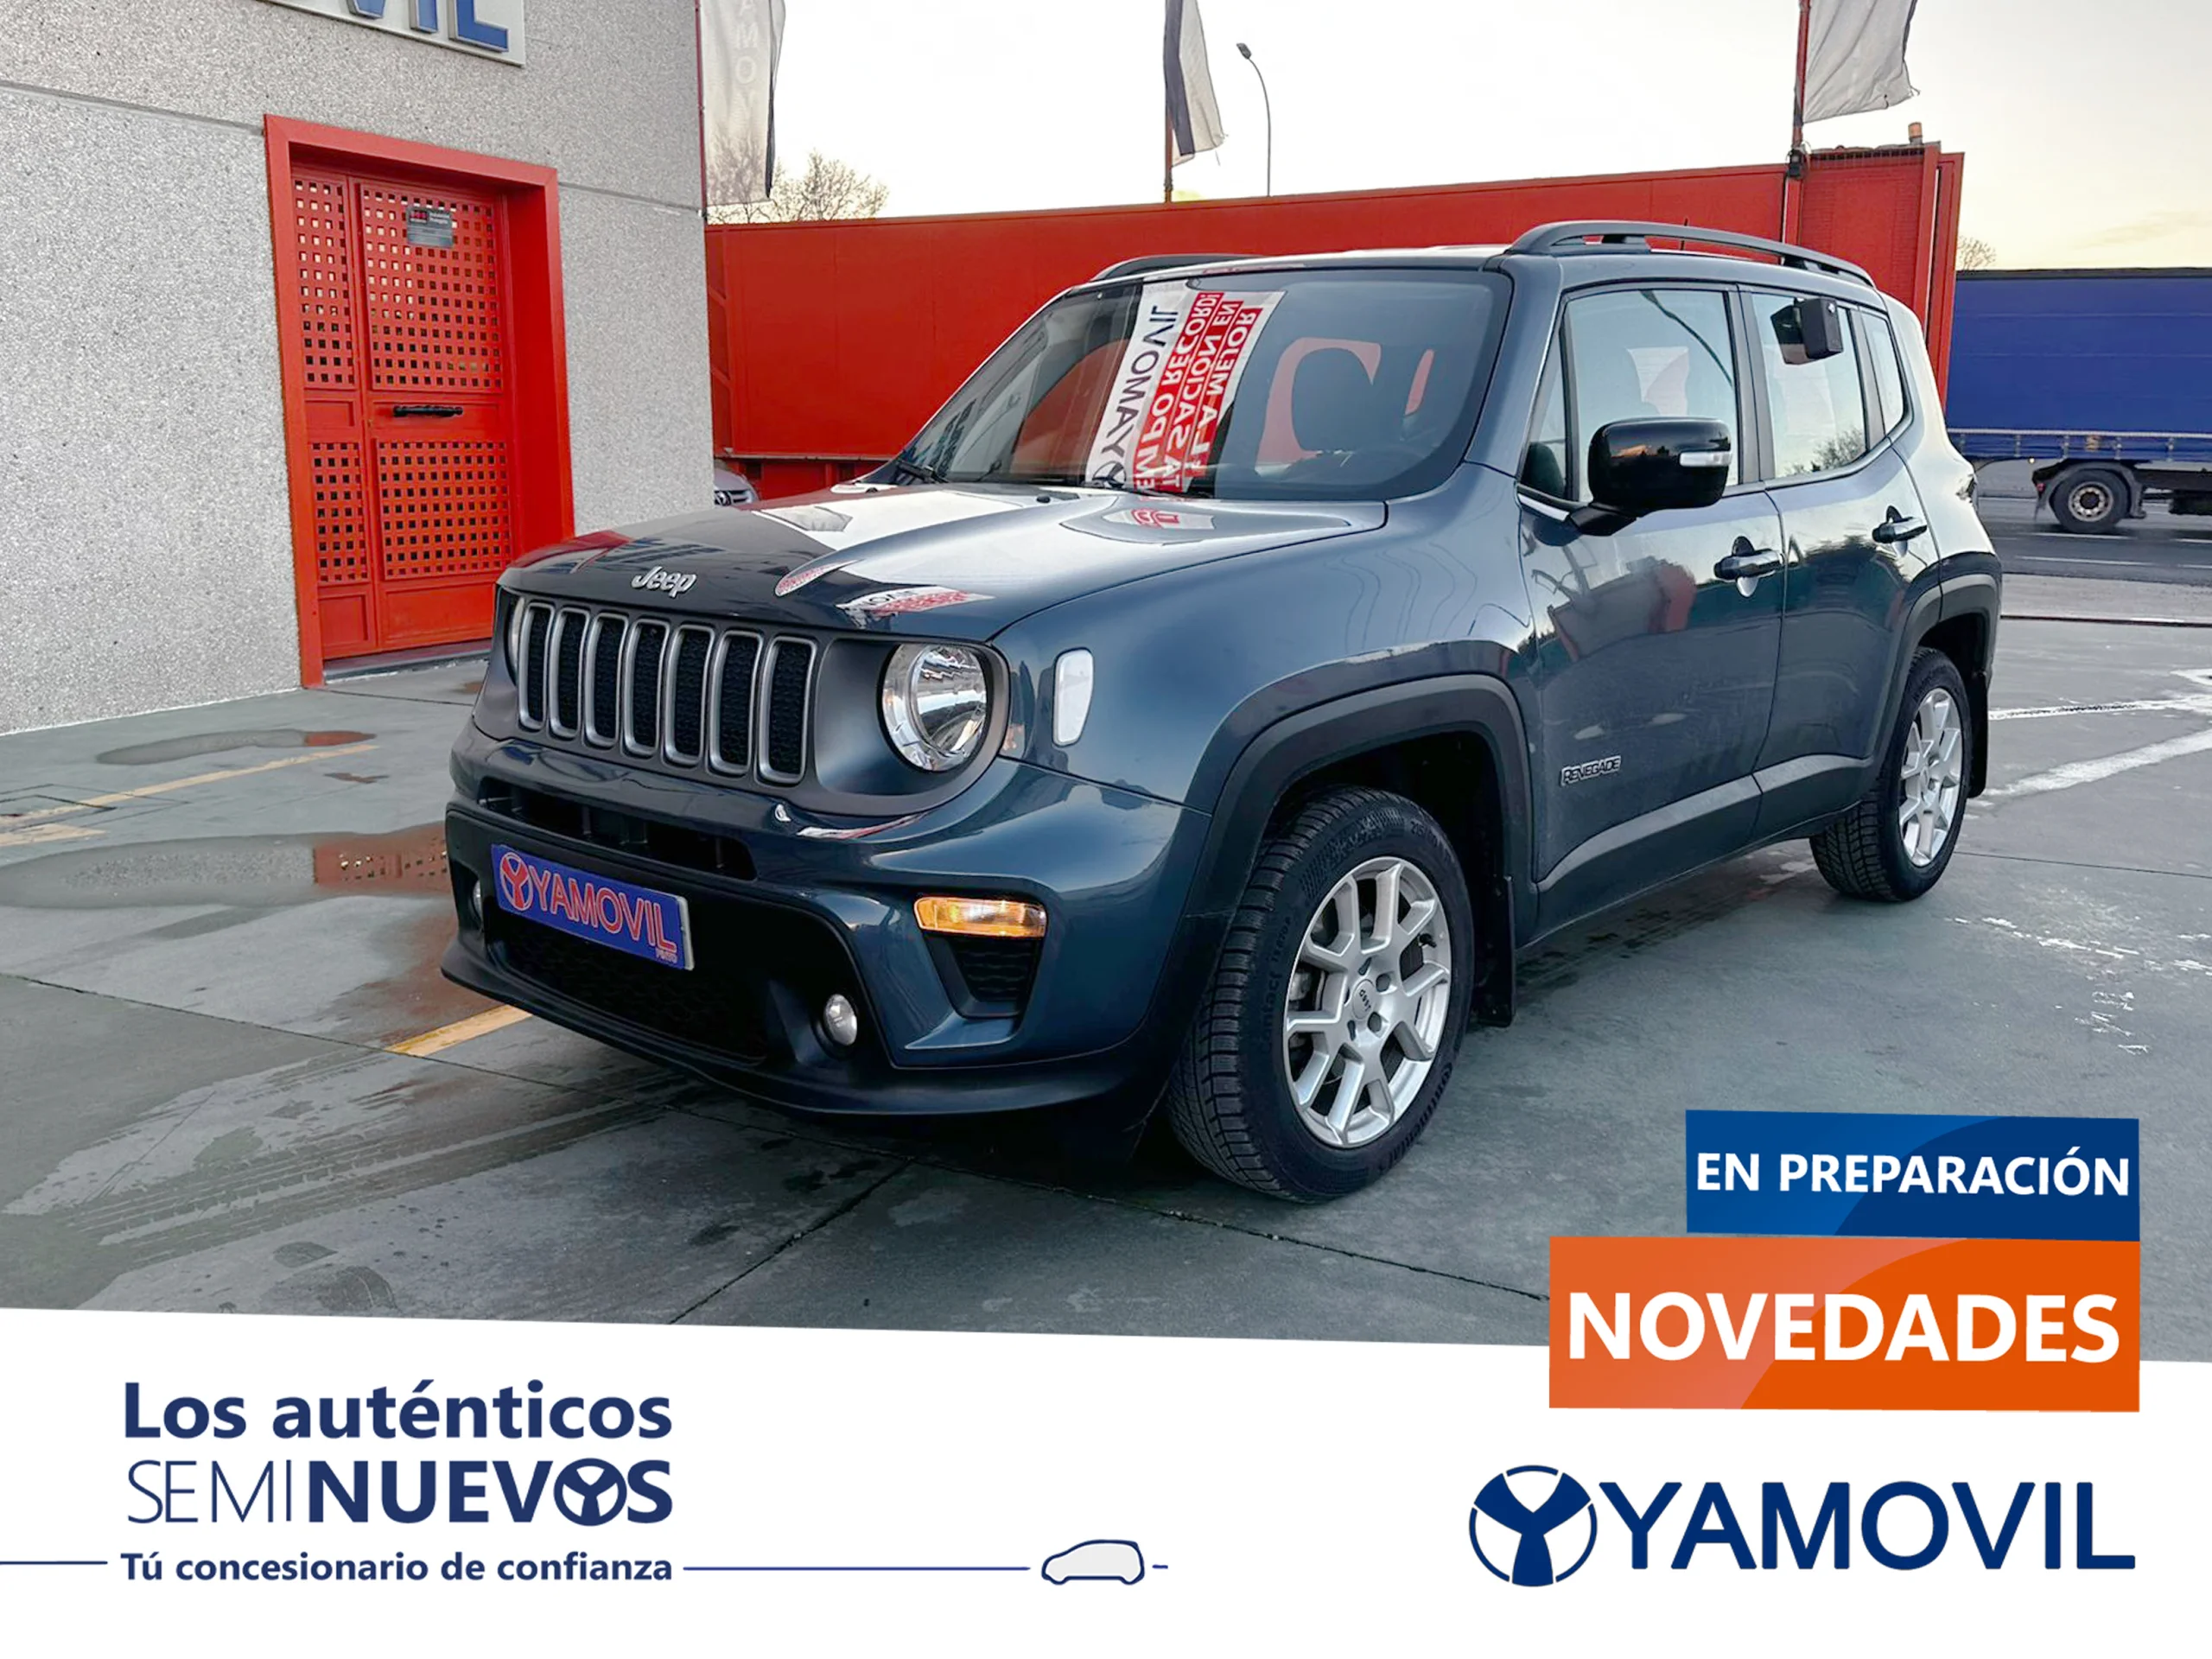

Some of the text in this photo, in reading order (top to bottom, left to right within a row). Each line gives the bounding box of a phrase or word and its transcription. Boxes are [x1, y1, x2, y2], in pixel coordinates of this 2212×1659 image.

[631, 566, 697, 598] Jeep
[1560, 754, 1622, 786] RENEGADE
[528, 865, 677, 954] YAMOVIL
